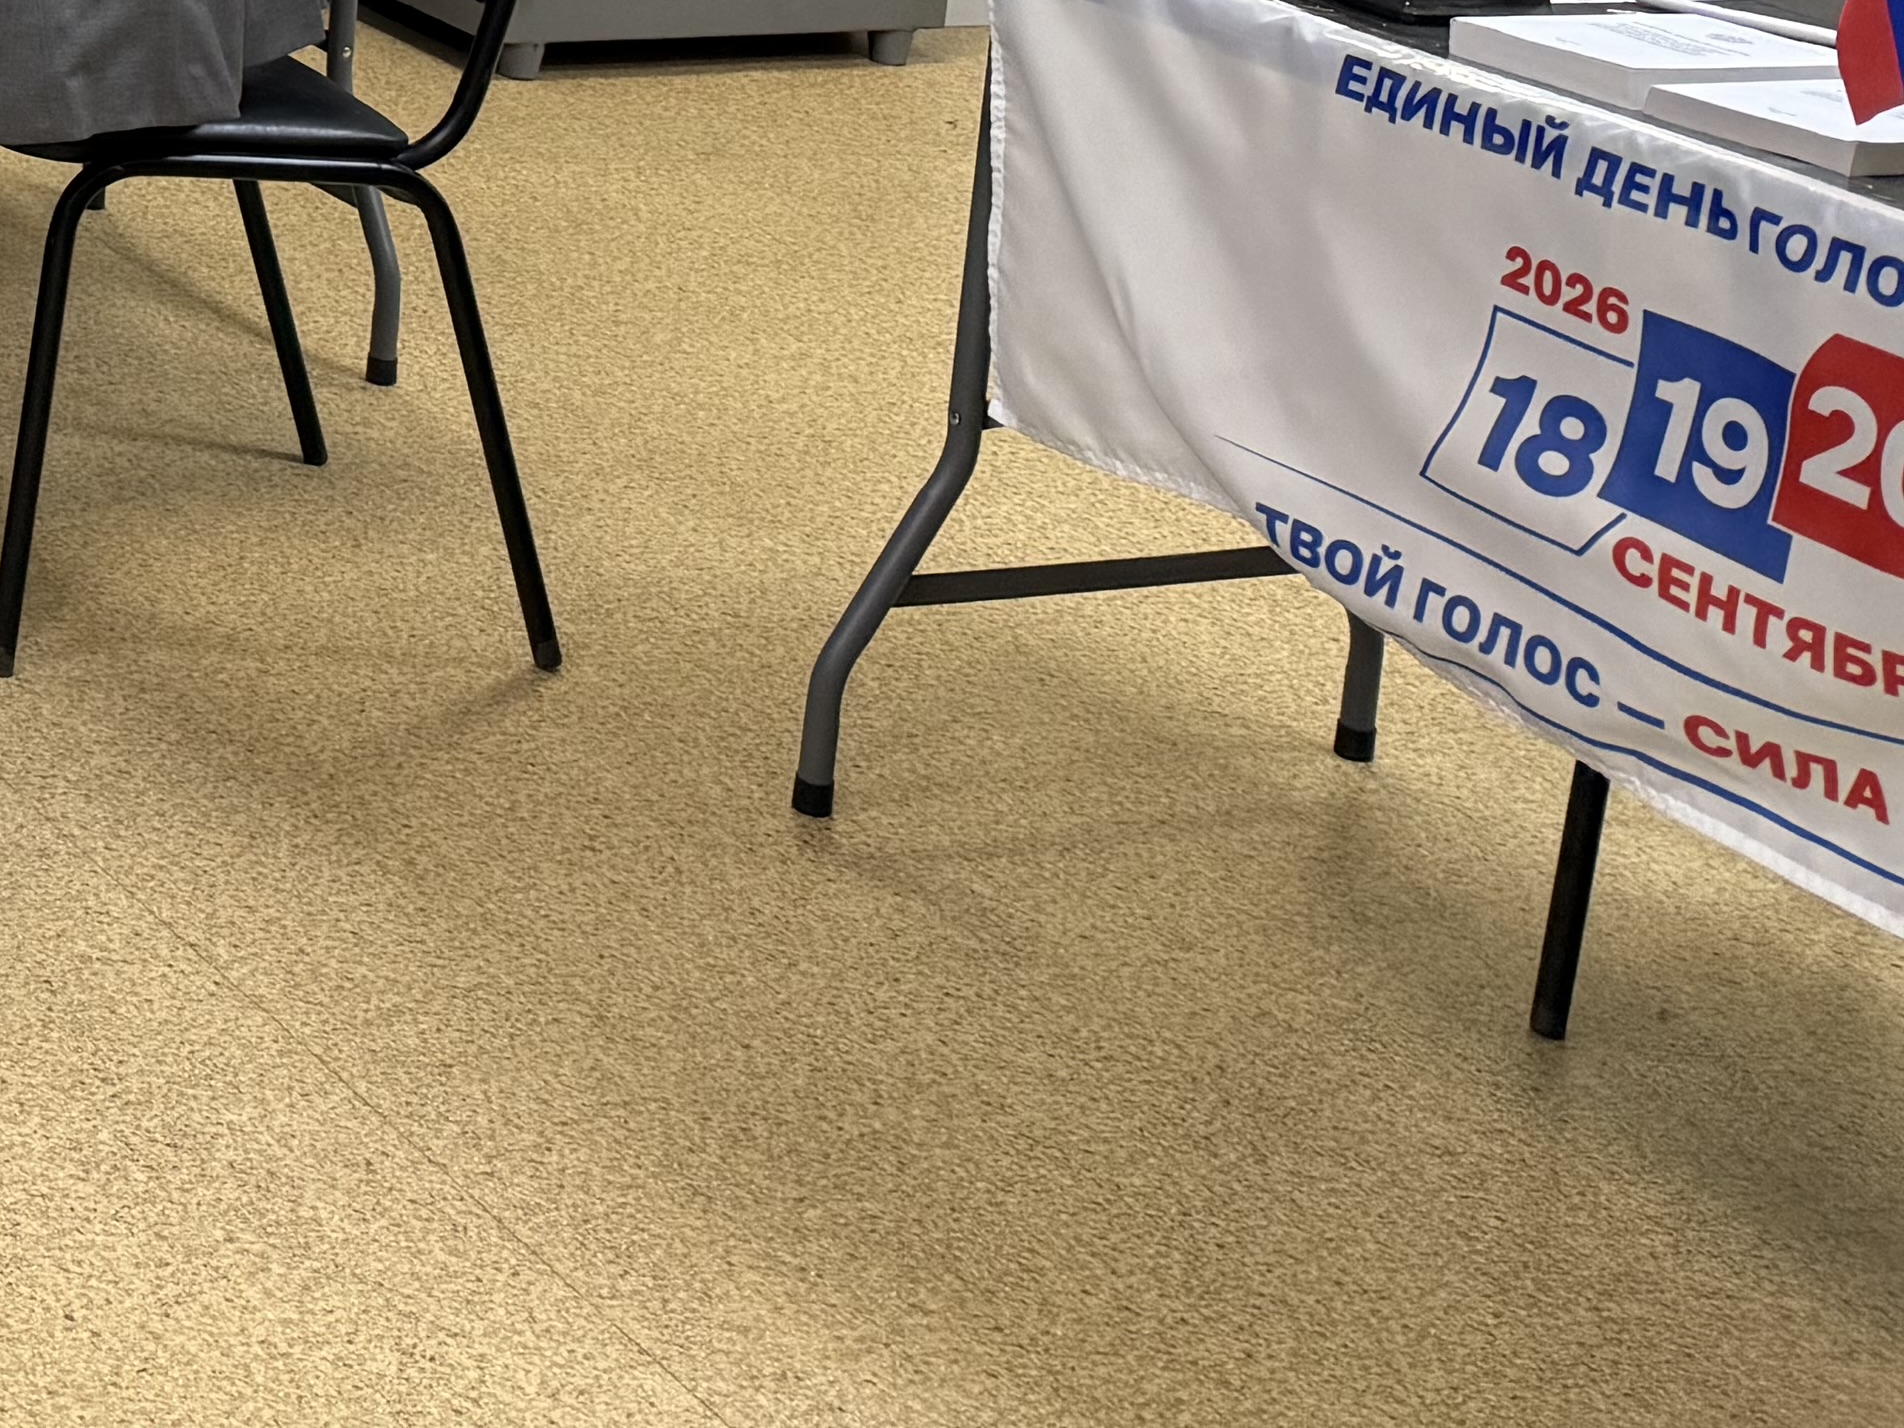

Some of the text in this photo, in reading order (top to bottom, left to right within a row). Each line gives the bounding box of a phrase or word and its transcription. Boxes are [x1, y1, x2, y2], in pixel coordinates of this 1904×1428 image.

[1335, 53, 1569, 180] ЕДИНЫЙ
[1574, 146, 1738, 241] ДЕНЬ
[1501, 245, 1630, 335] 2026
[1477, 374, 1608, 498] 18
[1653, 376, 1770, 510] 19
[1254, 501, 1405, 608] ТВОЙ
[1413, 578, 1601, 708] ГОЛОС
[1683, 714, 1890, 825] СИЛА
